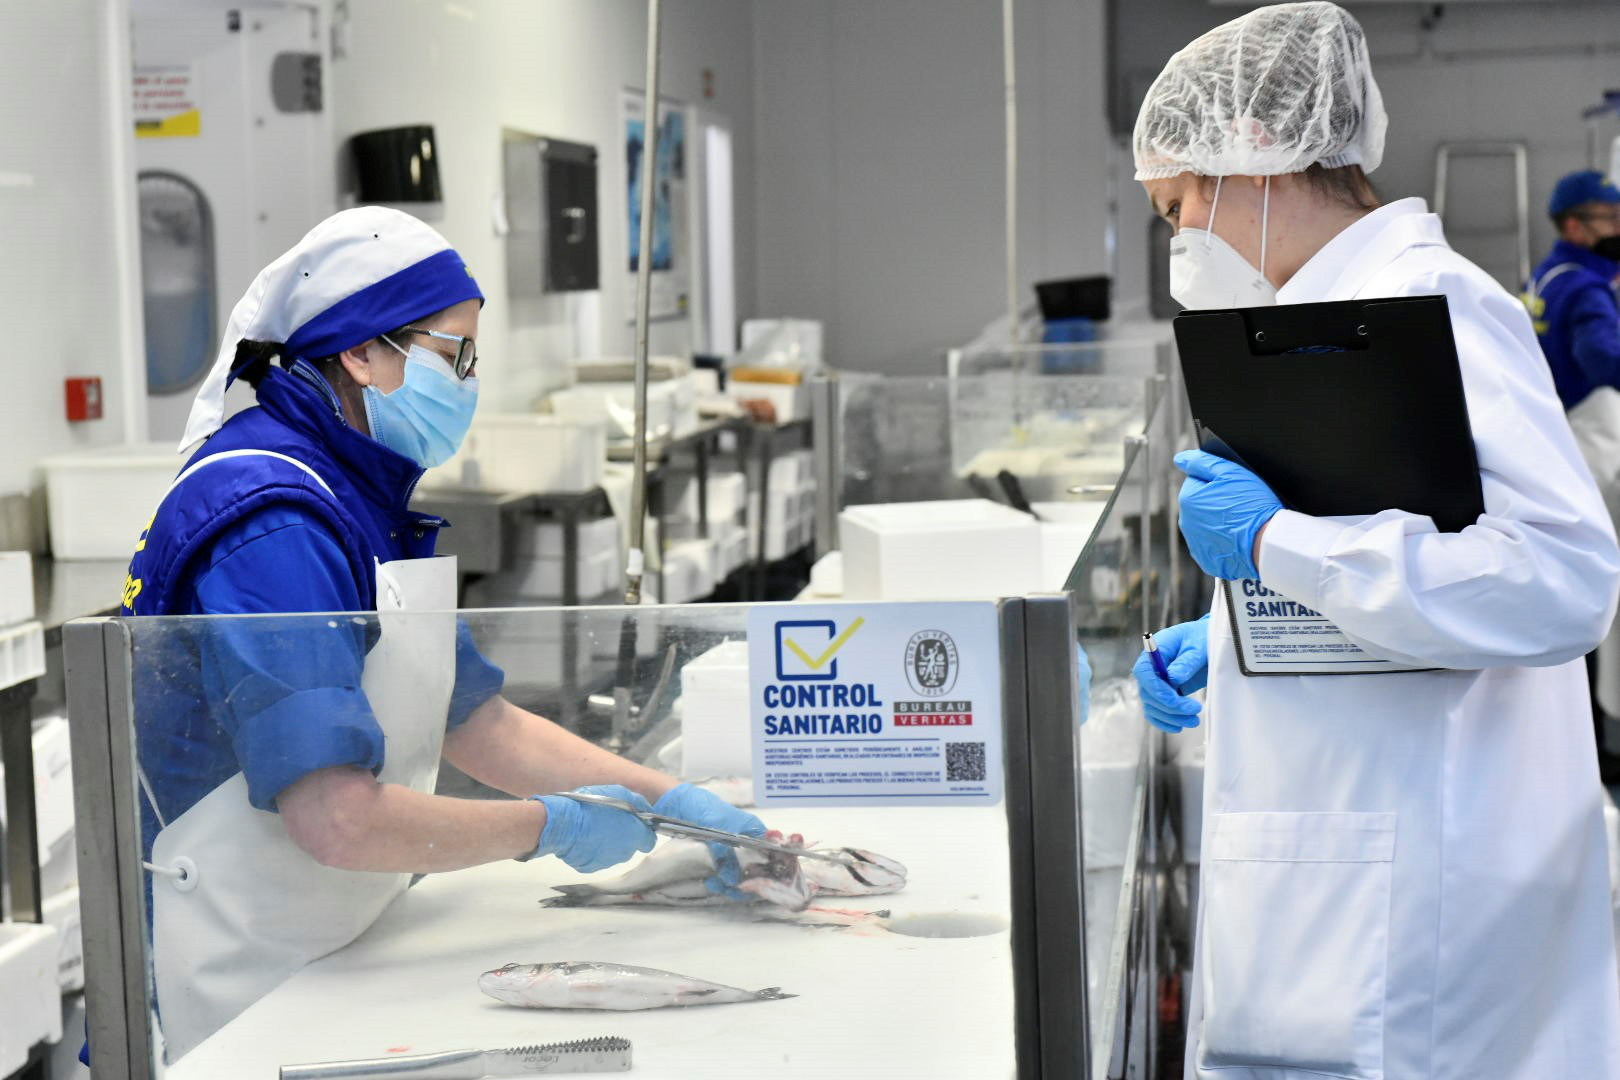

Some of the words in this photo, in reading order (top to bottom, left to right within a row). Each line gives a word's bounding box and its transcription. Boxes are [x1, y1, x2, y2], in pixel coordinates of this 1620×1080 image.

[1246, 601, 1323, 617] SANITA
[763, 683, 882, 708] CONTROL
[899, 702, 966, 712] BUREAU
[764, 713, 883, 735] SANITARIO
[900, 715, 967, 725] VERITAS
